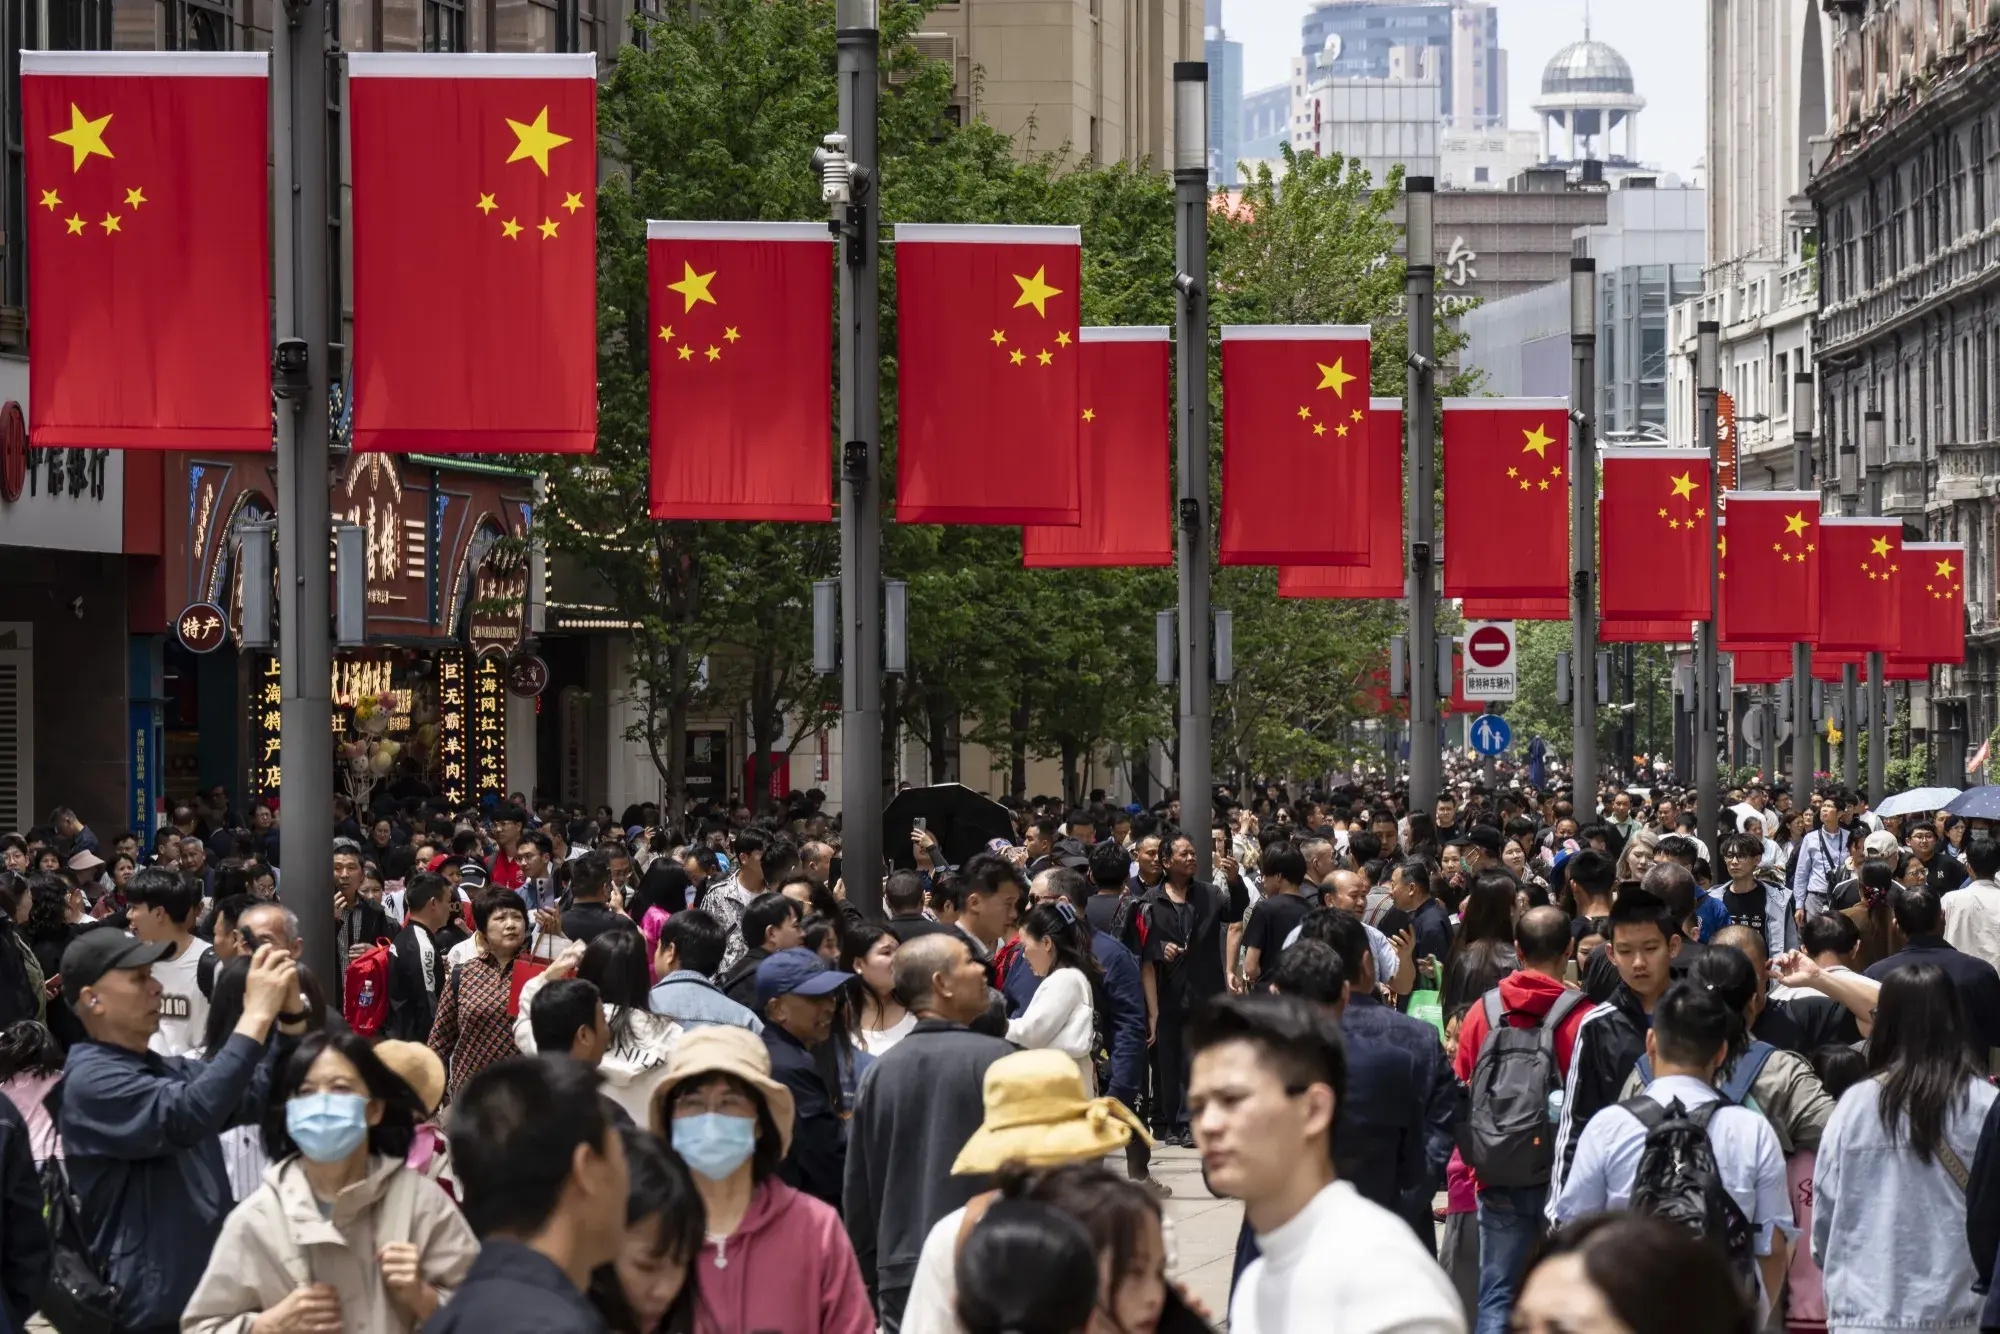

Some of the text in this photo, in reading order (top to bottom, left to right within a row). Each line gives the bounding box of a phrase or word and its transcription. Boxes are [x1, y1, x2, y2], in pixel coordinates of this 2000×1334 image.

[182, 616, 220, 640] 特产
[1468, 677, 1511, 690] 除特种车辆外
[264, 657, 281, 788] 上海特产店
[480, 658, 498, 789] 上海网红小吃城
[425, 951, 433, 985] VANS
